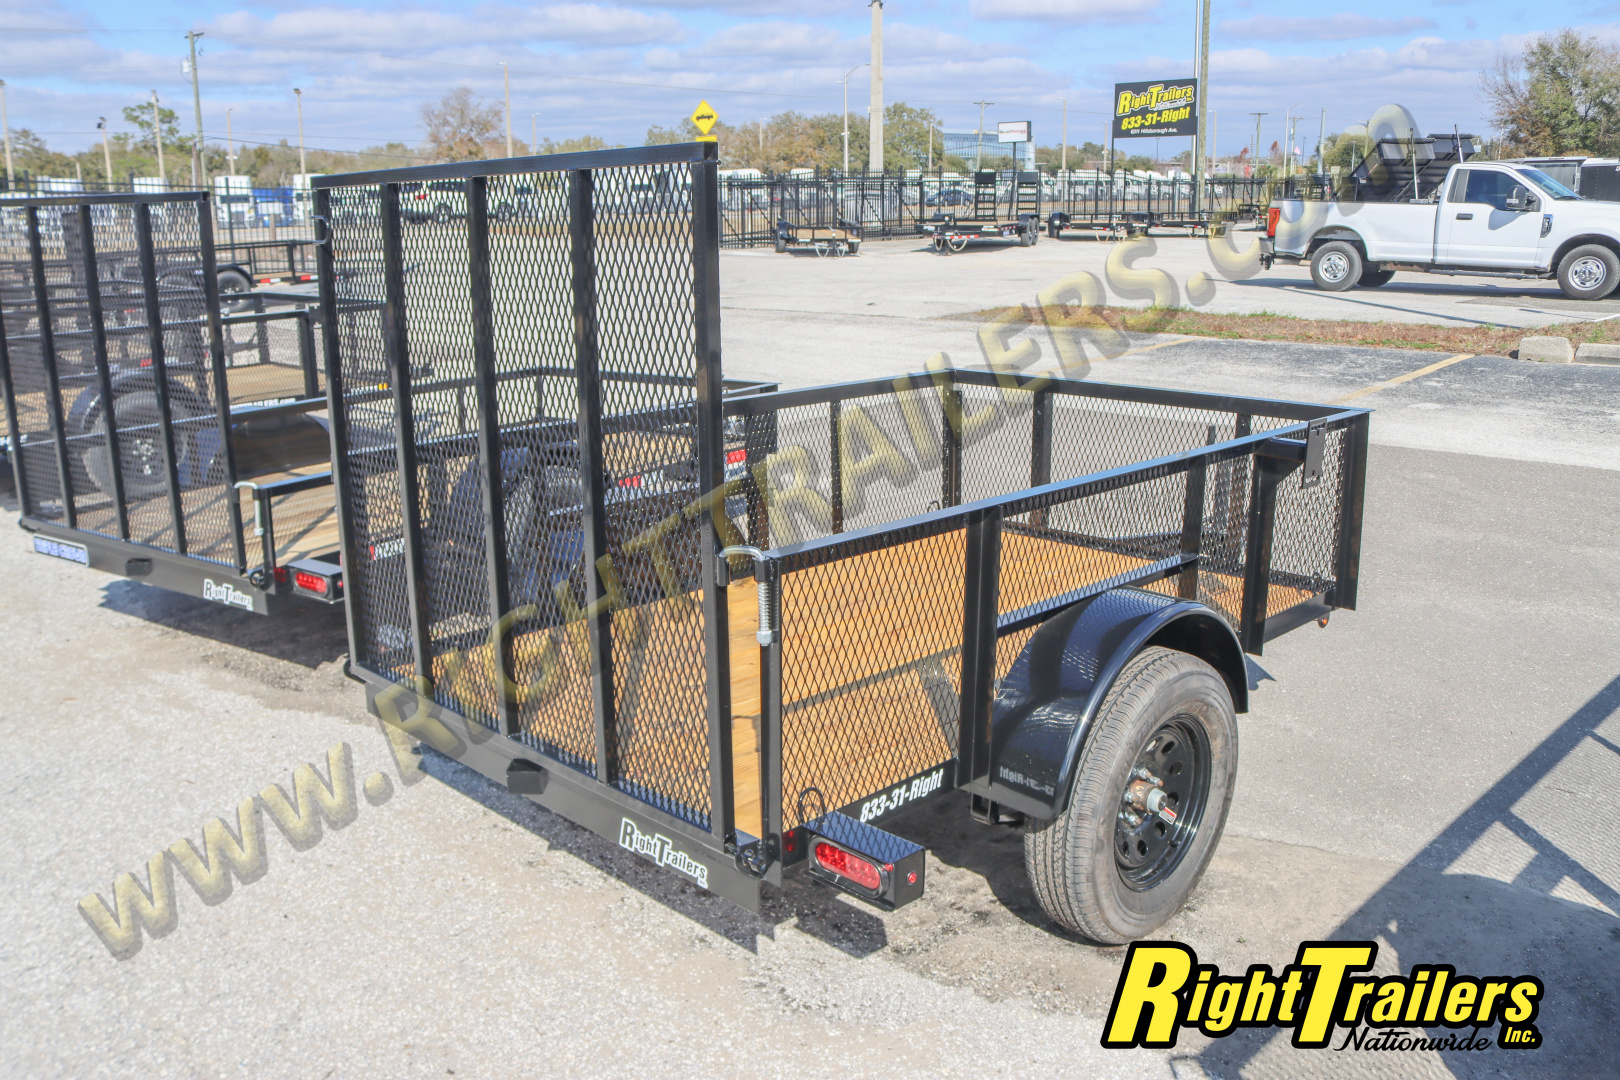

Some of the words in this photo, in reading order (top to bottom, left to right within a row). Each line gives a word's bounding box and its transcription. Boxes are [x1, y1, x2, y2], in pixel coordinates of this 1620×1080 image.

[1117, 84, 1193, 115] RightTrailers
[1121, 106, 1191, 130] 833-31-Right
[860, 768, 944, 823] 833-31-Right
[619, 817, 708, 880] RightTrailers
